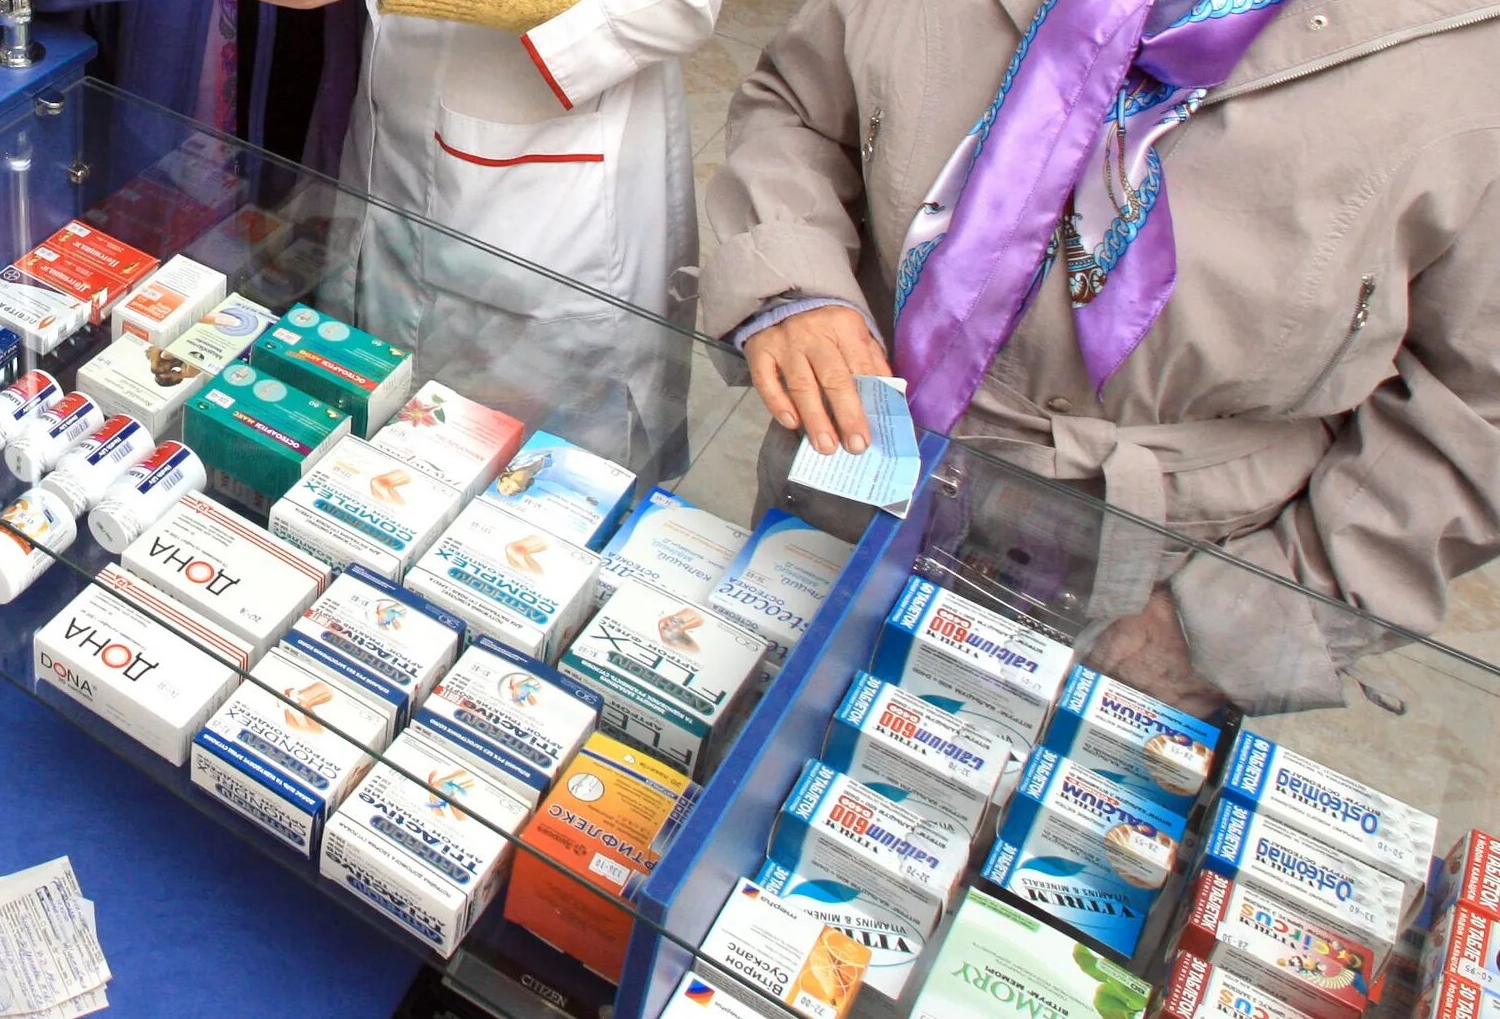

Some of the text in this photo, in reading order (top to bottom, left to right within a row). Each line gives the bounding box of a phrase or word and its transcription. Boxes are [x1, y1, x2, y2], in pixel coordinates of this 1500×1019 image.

[300, 479, 414, 542] COMPLEX
[148, 536, 241, 597] ДОНА
[434, 547, 556, 614] COMPLEX
[717, 580, 809, 629] teocare
[65, 616, 159, 681] ДОНА
[327, 621, 421, 677] TriActive
[589, 623, 728, 705] FLEX
[598, 619, 700, 672] АРТРОН ФЛЕКС
[40, 650, 95, 696] DONA
[224, 707, 338, 779] CHONDREX
[461, 699, 562, 759] TriActive
[598, 702, 696, 766] FLE
[294, 741, 342, 772] АРТРОН
[1239, 747, 1265, 791] ТАБЛЕТОК
[193, 762, 308, 836] CHONDREX
[1058, 792, 1111, 821] VITRUM
[1060, 780, 1158, 839] CALCIUM
[1273, 767, 1381, 835] Osteomag
[1274, 785, 1339, 819] VITRUM
[355, 790, 480, 875] TriActive
[362, 787, 483, 864] АРТРОН ТРИАКТИВ
[546, 802, 658, 869] РТИФЛЕКС
[824, 818, 879, 853] VITRUM
[1218, 814, 1246, 861] ТАБЛЕТОК
[1021, 877, 1068, 891] MINERALS
[1253, 837, 1354, 902] Osteomag
[1253, 854, 1318, 888] VITRUM
[1478, 852, 1500, 911] ТАБЛЕТОК
[323, 850, 448, 937] TriActive
[759, 894, 798, 920] mepha
[1026, 888, 1133, 918] VITRUM
[1079, 888, 1128, 902] VITAMINS
[1199, 882, 1226, 929] ТАБЛЕТОК
[1347, 904, 1376, 923] 33-60
[855, 916, 907, 932] VITAMINS
[1220, 932, 1249, 951] 28-30
[1237, 916, 1297, 949] VITRUM
[1469, 912, 1486, 928] 30
[723, 954, 783, 996] Вітирон
[725, 941, 790, 984] Сускапс
[519, 973, 566, 1006] CITIZEN
[950, 959, 1058, 1019] EMORY
[1458, 983, 1475, 999] 30
